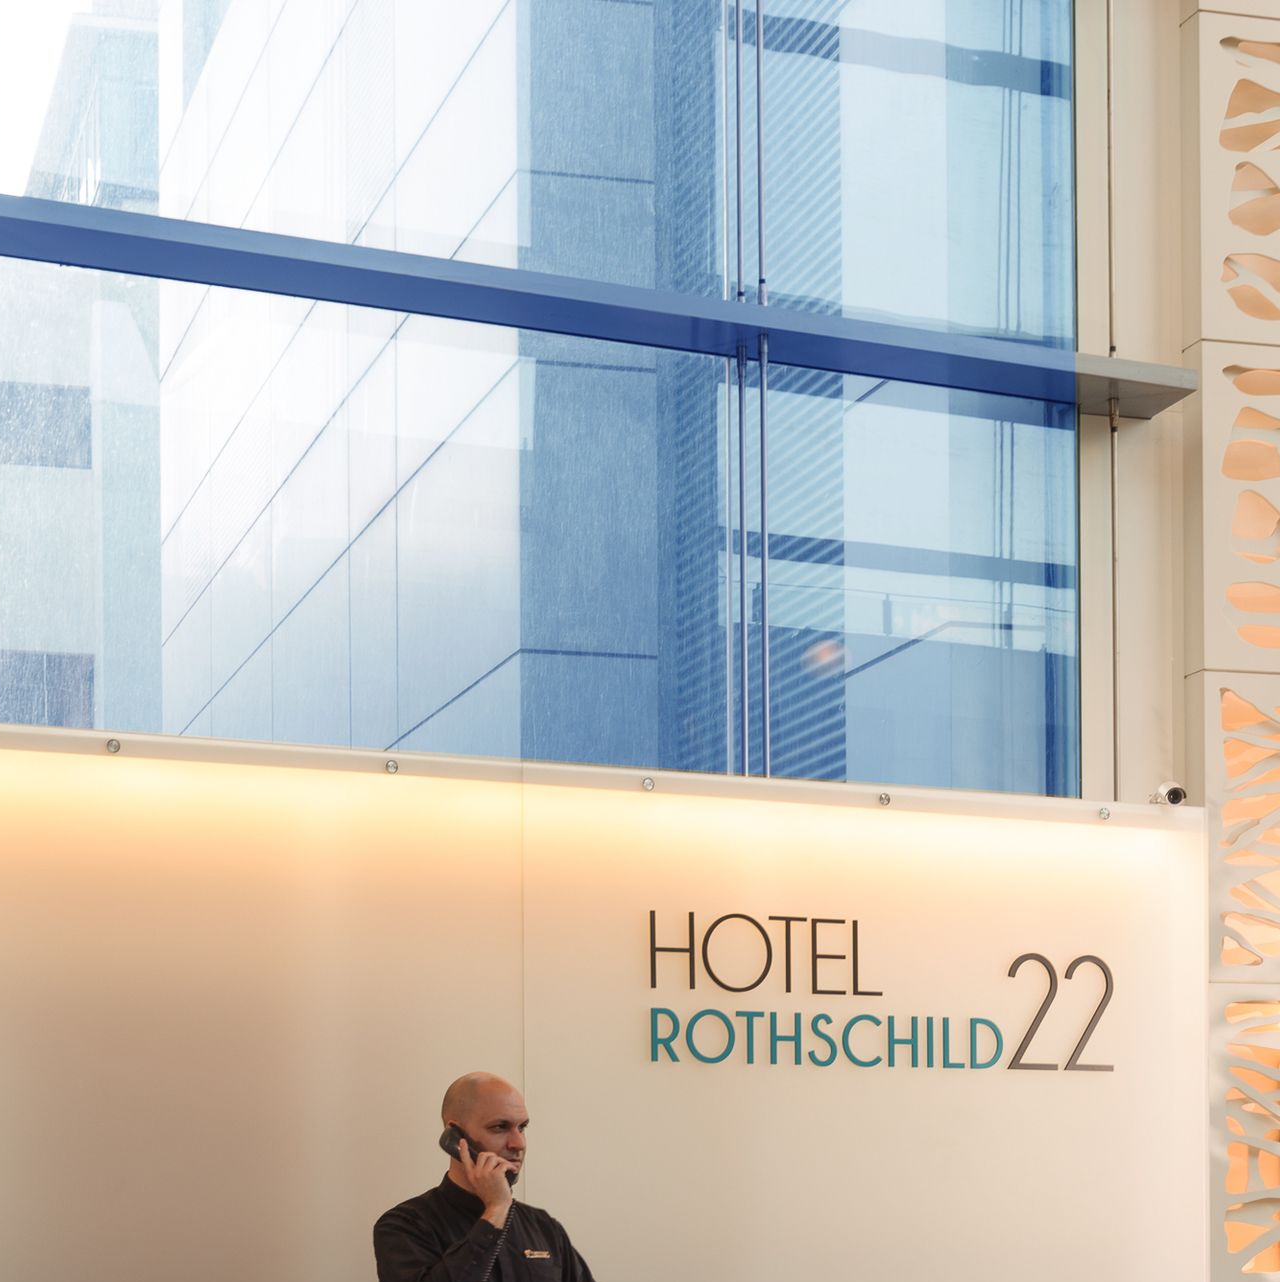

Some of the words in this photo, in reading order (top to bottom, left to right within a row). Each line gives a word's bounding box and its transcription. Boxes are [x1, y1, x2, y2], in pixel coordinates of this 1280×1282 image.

[650, 910, 883, 996] HOTEL
[650, 1008, 1004, 1070] ROTHSCHILD
[1007, 953, 1114, 1071] 22
